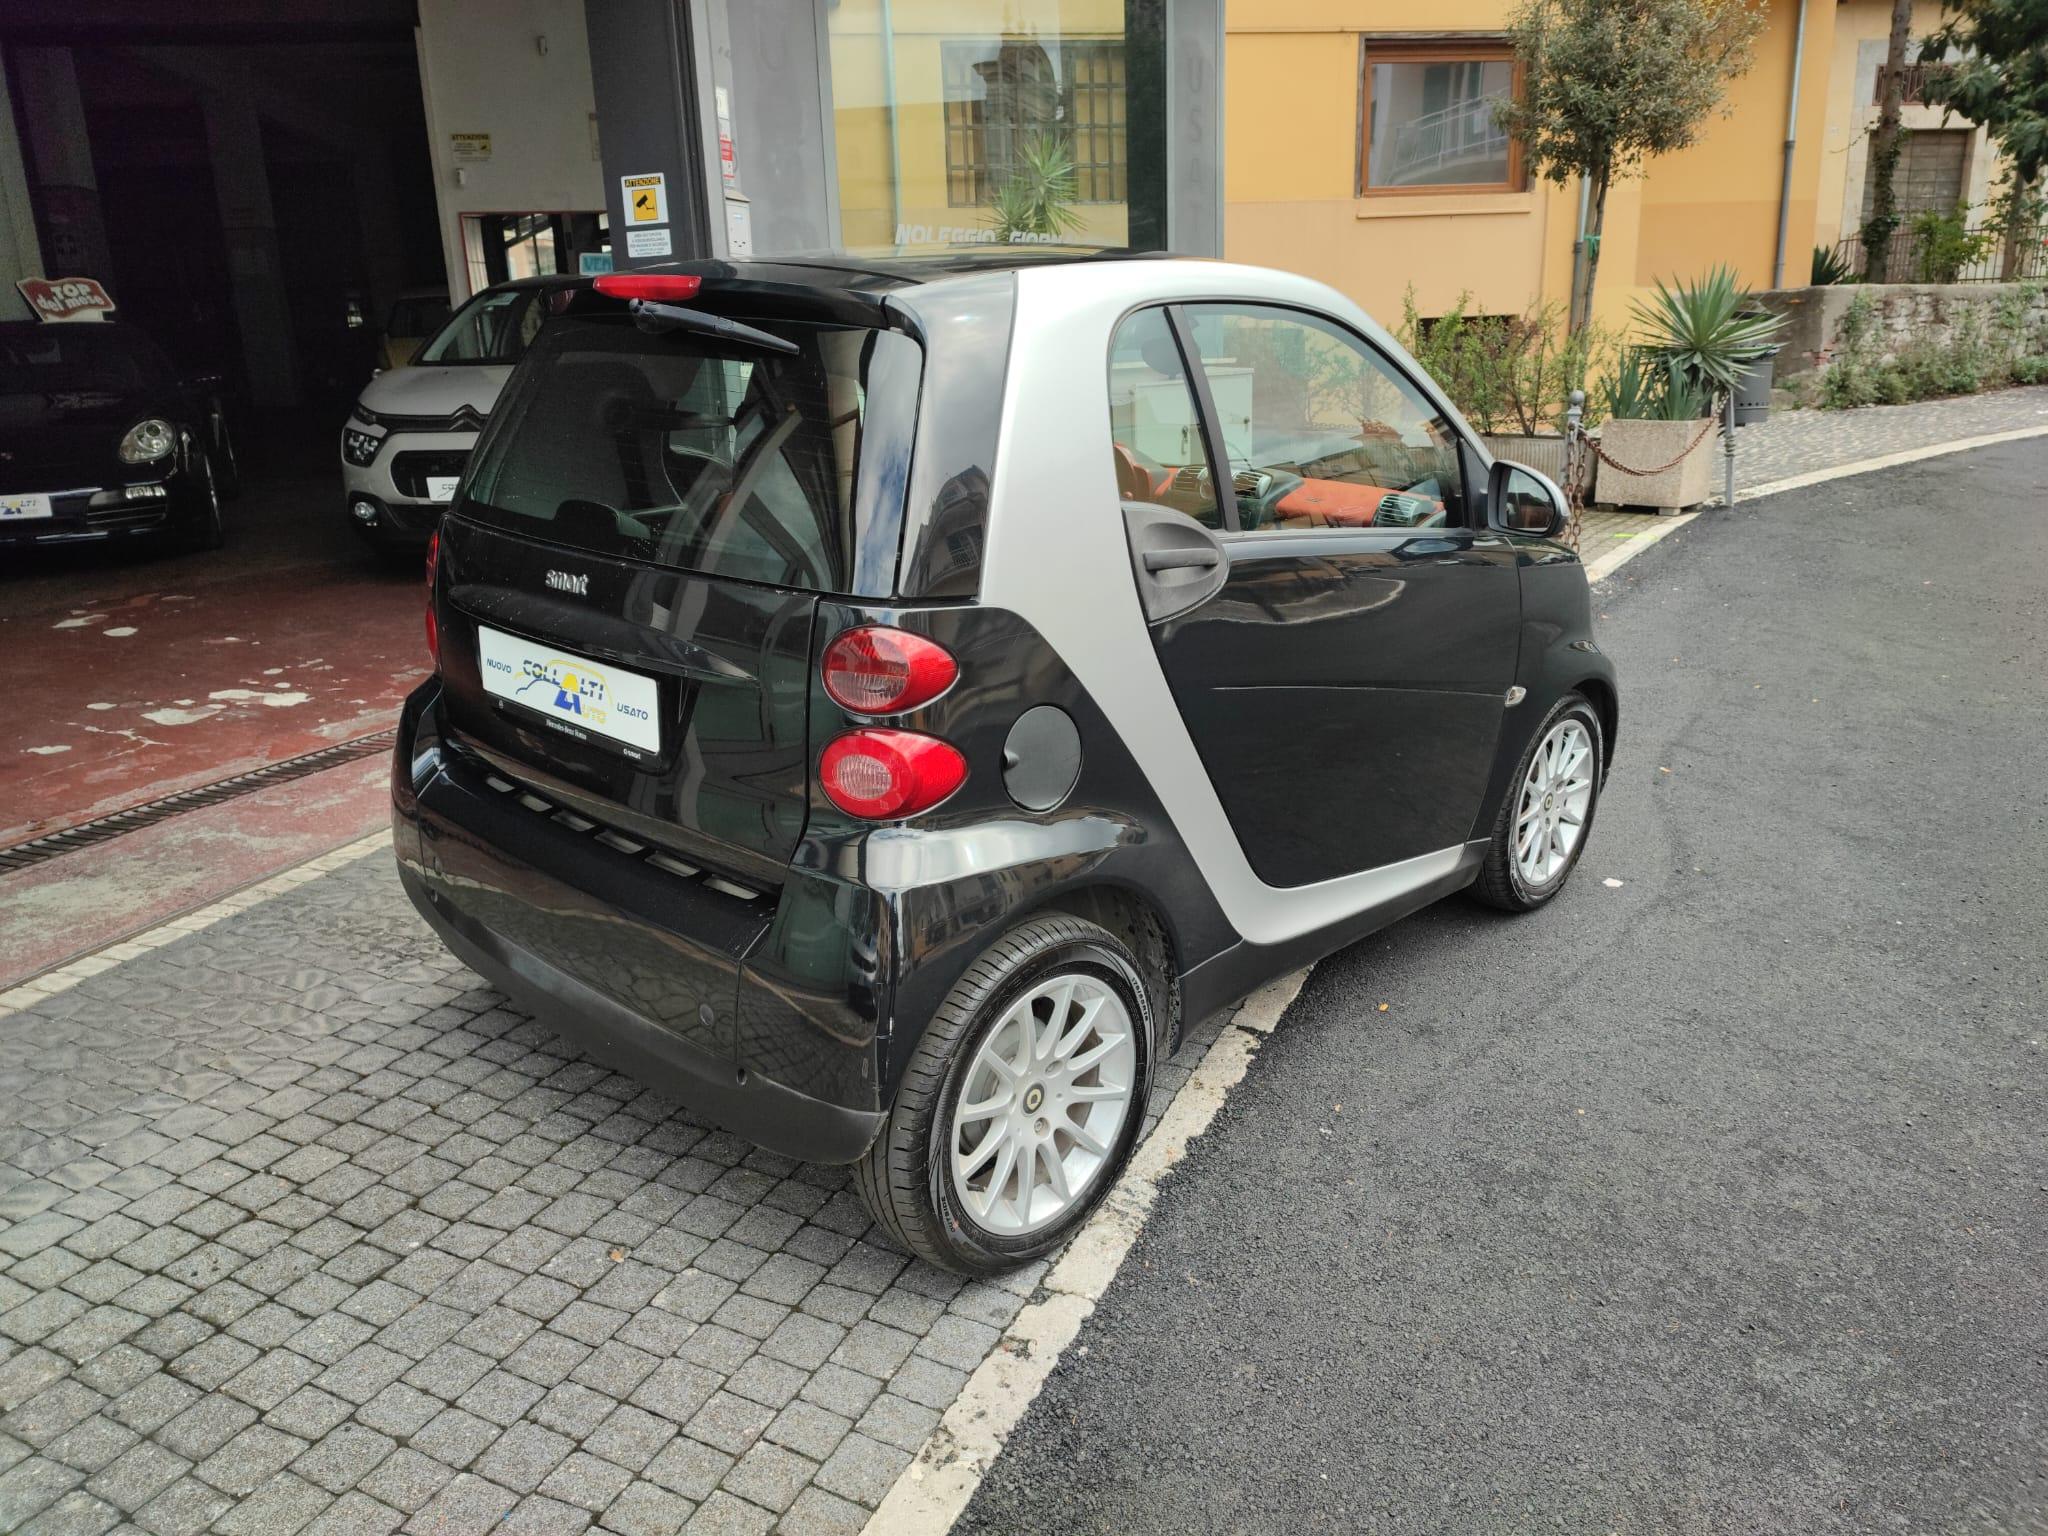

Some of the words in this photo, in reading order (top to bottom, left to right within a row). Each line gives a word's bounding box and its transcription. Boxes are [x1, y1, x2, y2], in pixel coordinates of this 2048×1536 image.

[36, 293, 65, 312] del
[64, 295, 105, 308] mese
[50, 283, 91, 300] TOP
[545, 569, 590, 596] smart
[486, 658, 512, 674] NUOVO
[616, 702, 649, 721] USATO
